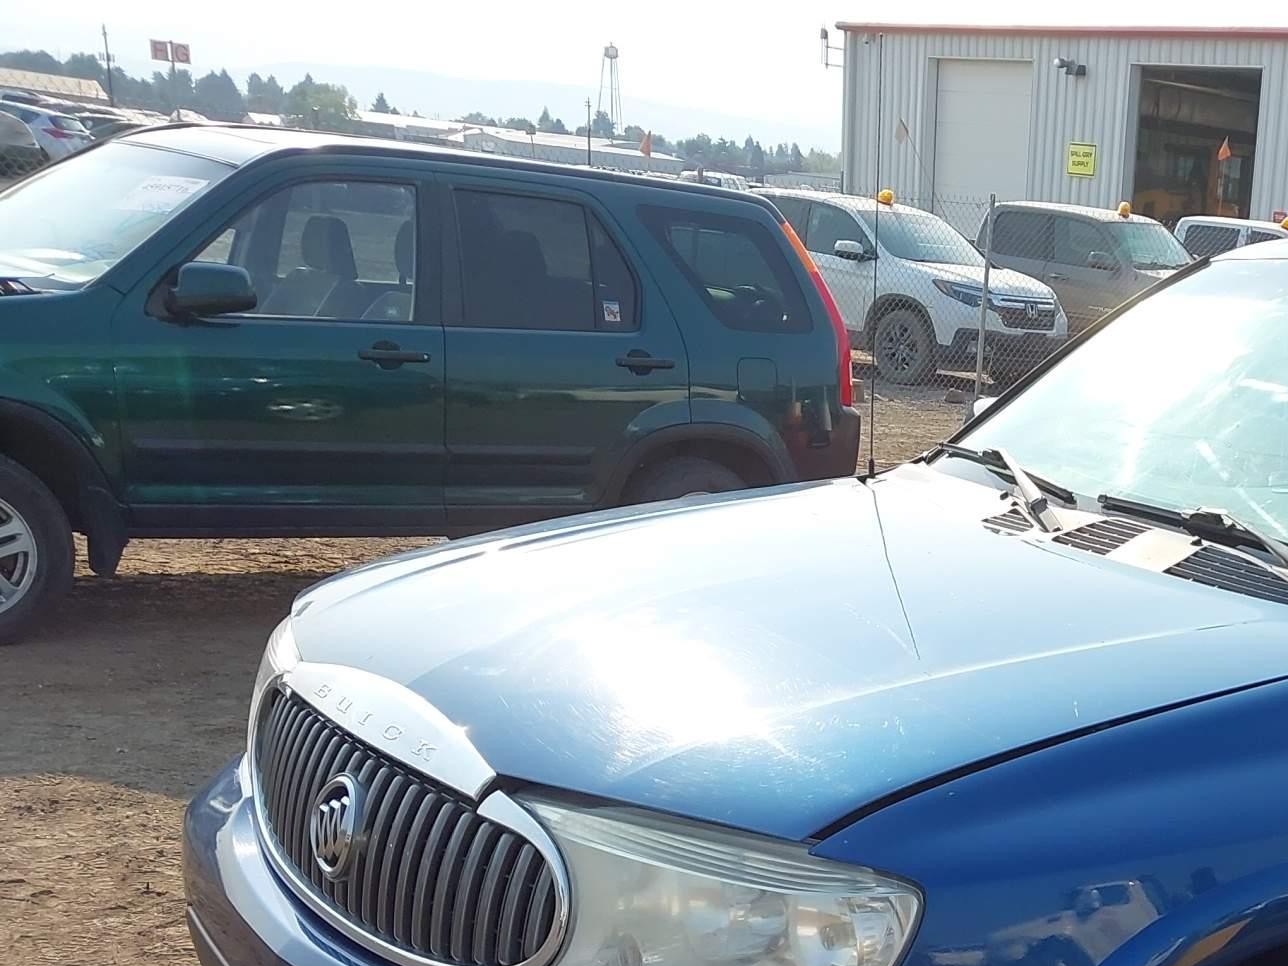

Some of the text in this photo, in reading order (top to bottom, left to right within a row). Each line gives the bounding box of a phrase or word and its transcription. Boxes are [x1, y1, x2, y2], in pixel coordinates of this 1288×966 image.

[175, 44, 189, 63] G
[1071, 160, 1089, 168] SUPPLY
[312, 684, 438, 762] BUICK
